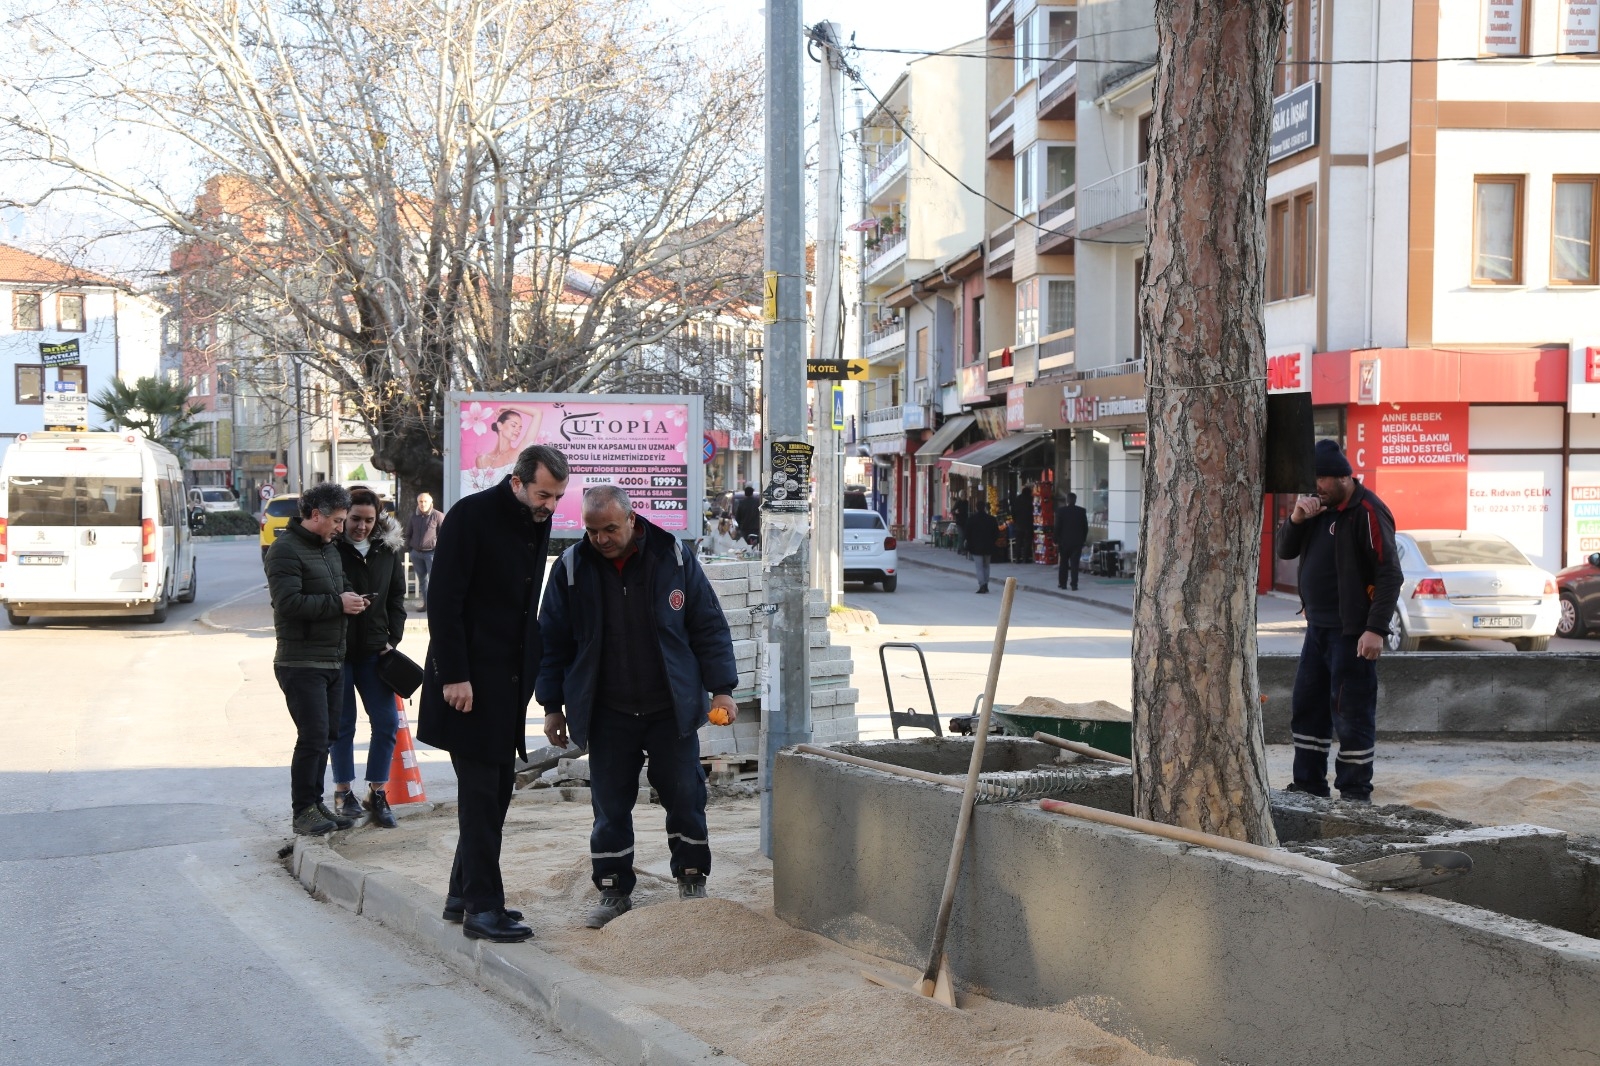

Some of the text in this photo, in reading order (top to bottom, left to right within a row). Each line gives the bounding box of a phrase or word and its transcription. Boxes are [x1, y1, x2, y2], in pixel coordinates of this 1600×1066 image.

[1290, 100, 1308, 129] İNŞAAT
[42, 344, 77, 353] anka
[44, 351, 79, 361] SATILIK
[806, 363, 839, 373] İK OTEL
[59, 394, 86, 402] Bursa
[1382, 412, 1442, 422] ANNE BEBEK
[573, 420, 669, 434] UTOPIA
[1382, 423, 1424, 432] MEDİKAL
[1382, 433, 1450, 445] KİŞİSEL BAKIM
[1382, 442, 1452, 454] BESİN DESTEĞİ
[590, 453, 601, 461] İLE
[602, 453, 666, 461] HİZMETİNİZDEYİZ
[1382, 453, 1466, 465] DERMO KOZMETİK
[572, 465, 593, 473] VÜCUT
[594, 465, 614, 473] DİODE
[648, 465, 682, 473] EPİLASYON
[646, 489, 651, 497] 6
[652, 489, 673, 497] SEANS
[1469, 487, 1552, 499] Ecz. Rıdvan ÇELİK
[1511, 504, 1525, 512] 371
[1527, 504, 1537, 512] 26
[1539, 504, 1549, 512] 26
